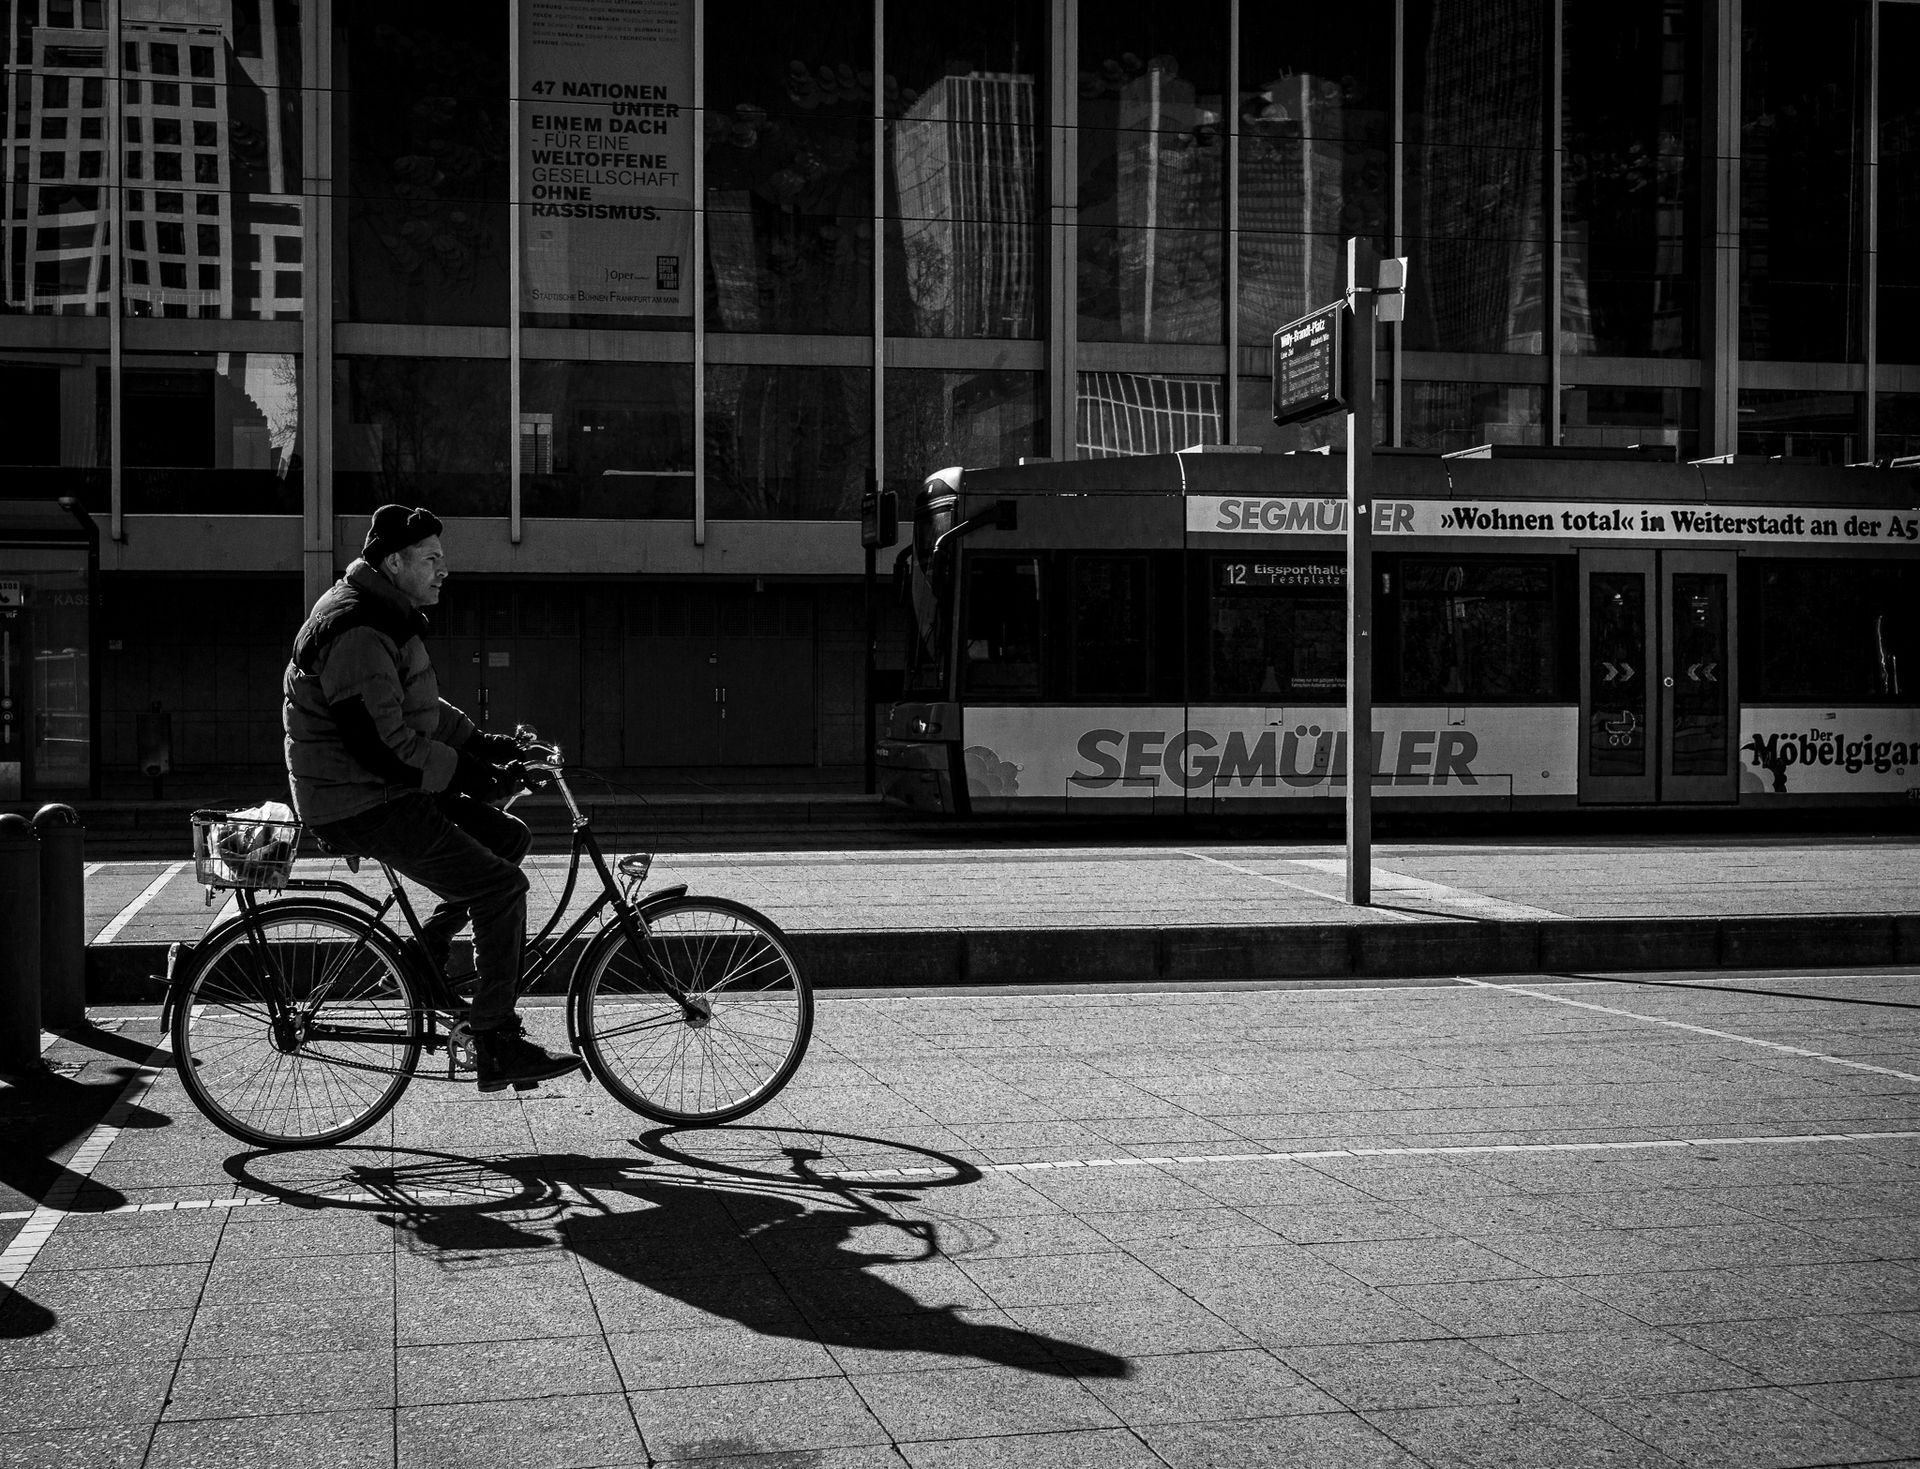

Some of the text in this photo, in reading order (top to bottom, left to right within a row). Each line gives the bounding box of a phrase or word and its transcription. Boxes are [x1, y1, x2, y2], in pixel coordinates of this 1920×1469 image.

[532, 81, 668, 100] 47 NATIONEN
[612, 102, 679, 118] UNTER
[532, 115, 668, 135] EINEM DACH
[544, 132, 581, 149] FÜR
[587, 135, 629, 151] EINE
[532, 150, 668, 169] WELTOFFENE
[532, 167, 679, 187] GESELLSCHAFT
[532, 184, 592, 201] OHNE
[532, 203, 661, 221] RASSISMUS.
[610, 270, 634, 282] Oper
[1215, 499, 1415, 533] SEGMÜER
[1641, 510, 1666, 532] in
[1671, 510, 1805, 535] Weiterstadt
[1810, 519, 1838, 536] an
[1844, 515, 1882, 537] der
[1887, 516, 1919, 540] A5
[1226, 564, 1247, 584] 12
[1271, 574, 1340, 585] Festplatz
[1810, 728, 1833, 741] Der
